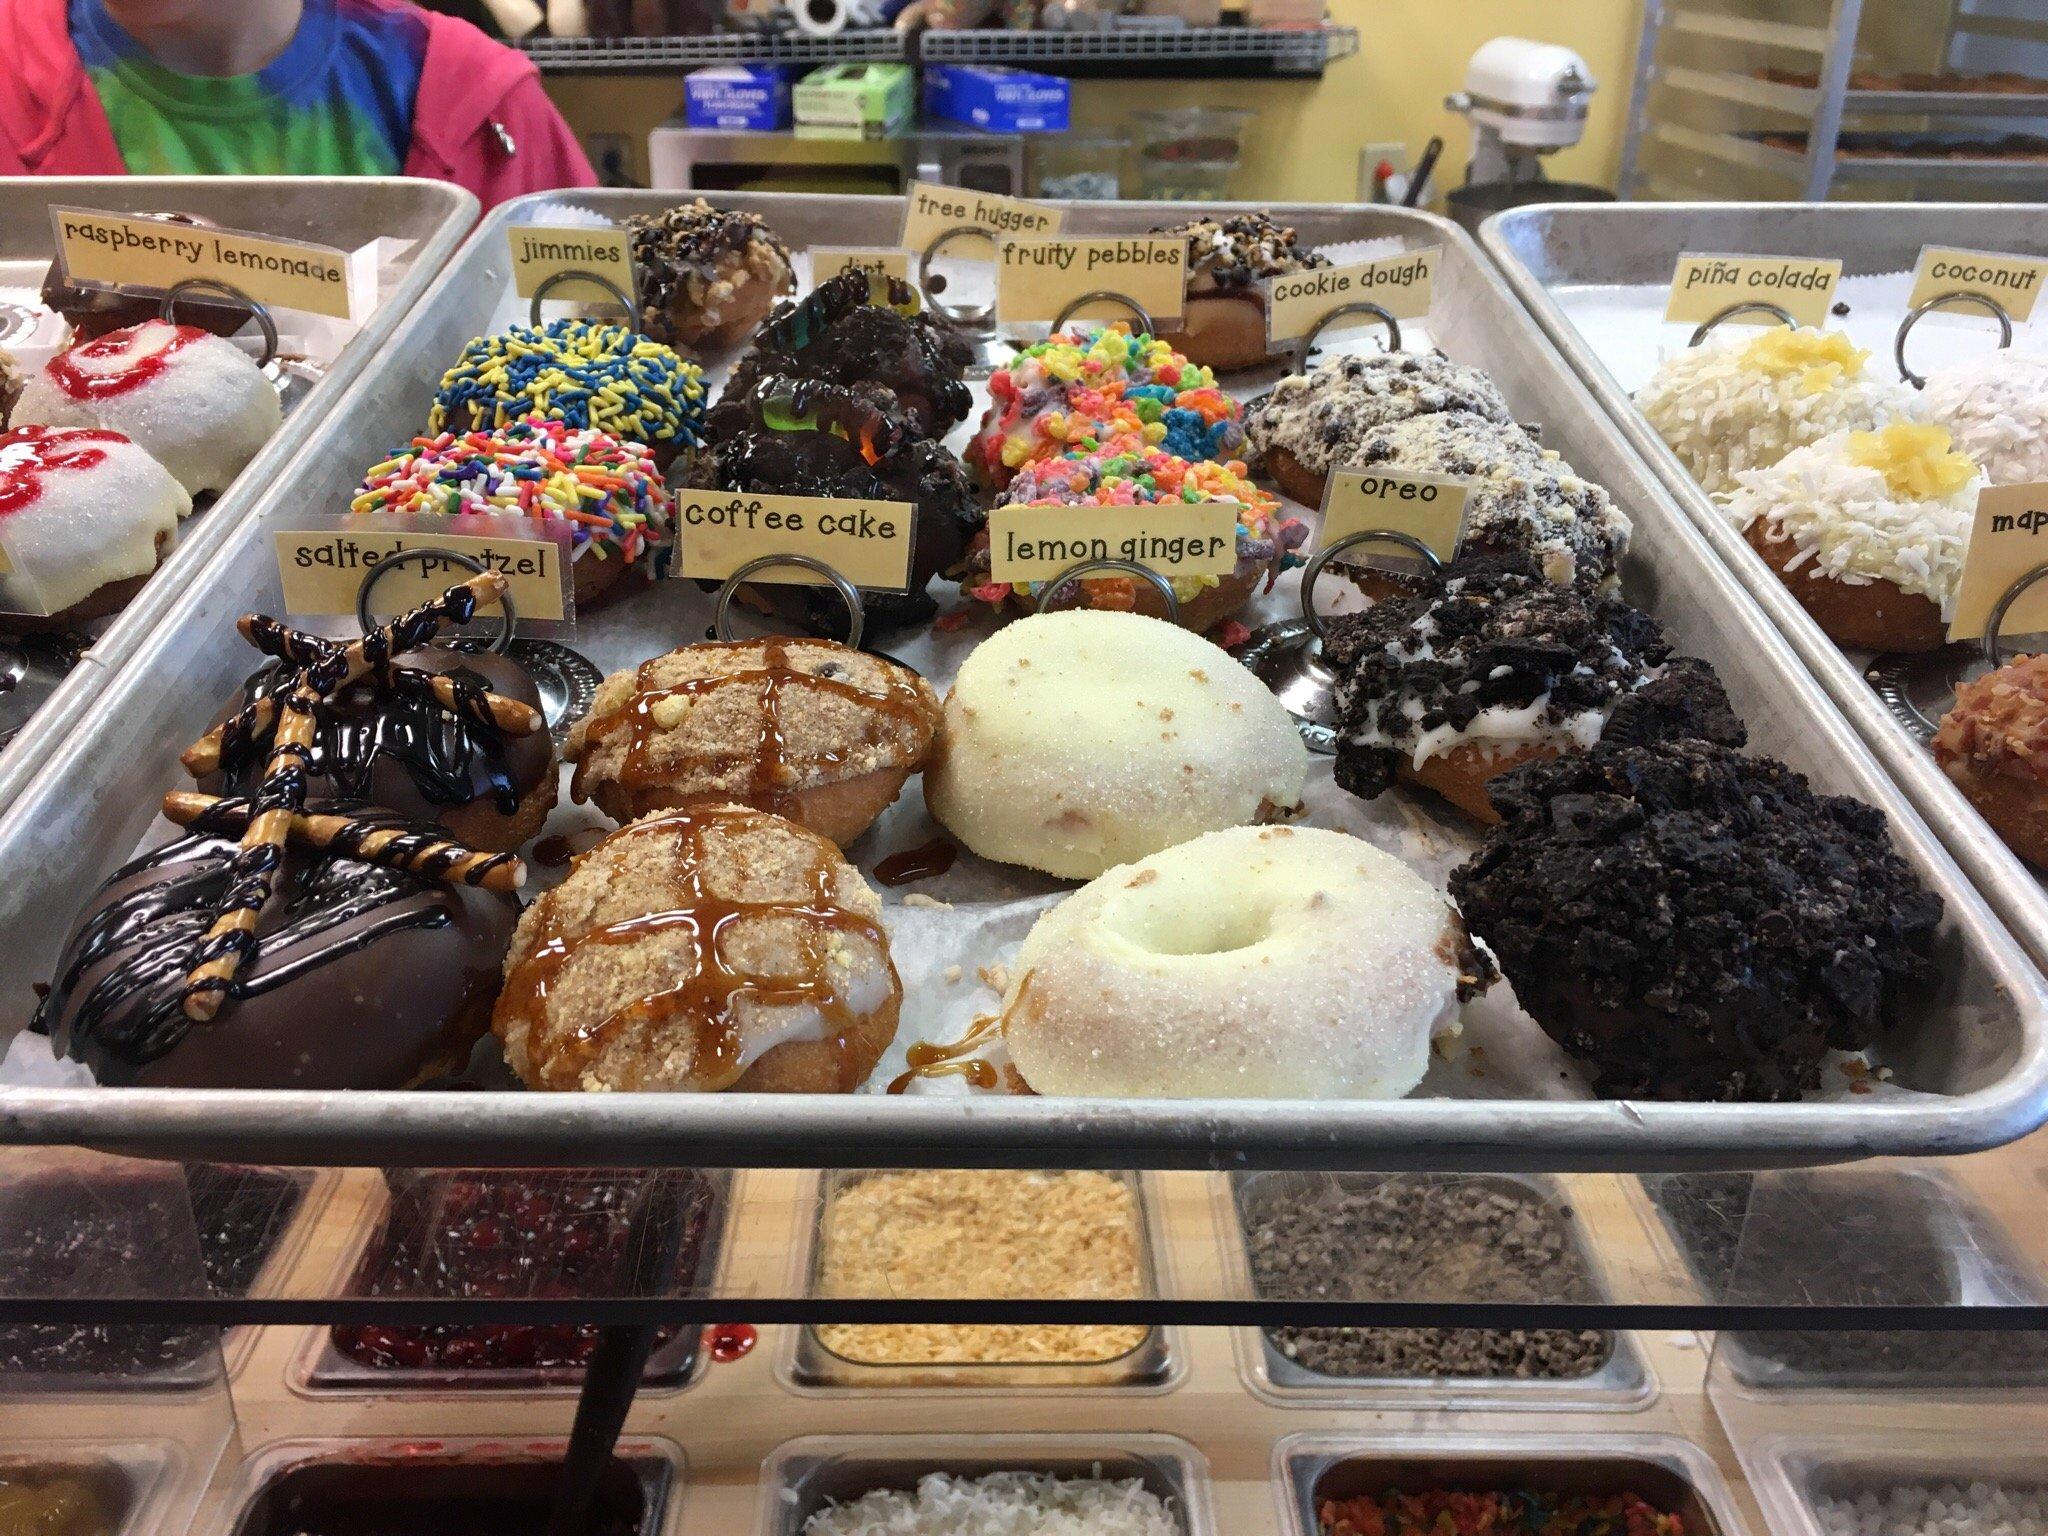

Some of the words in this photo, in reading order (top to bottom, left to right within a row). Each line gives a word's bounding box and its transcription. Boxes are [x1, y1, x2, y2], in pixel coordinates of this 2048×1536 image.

[918, 193, 966, 219] tree
[974, 200, 1048, 232] hugger
[64, 222, 203, 263] raspberry
[214, 239, 341, 283] lemonade
[519, 237, 620, 263] jimmies
[1003, 242, 1077, 270] fruity
[1087, 241, 1181, 271] pebbles
[1275, 272, 1350, 301] cookie
[1360, 258, 1428, 287] dough
[1685, 261, 1741, 290] piña
[1747, 264, 1832, 291] colada
[1931, 262, 2038, 290] coconut
[1360, 477, 1438, 502] oreo
[685, 499, 804, 531] coffee
[817, 509, 897, 539] cake
[1006, 531, 1108, 562] lemon
[1120, 530, 1227, 564] ginger
